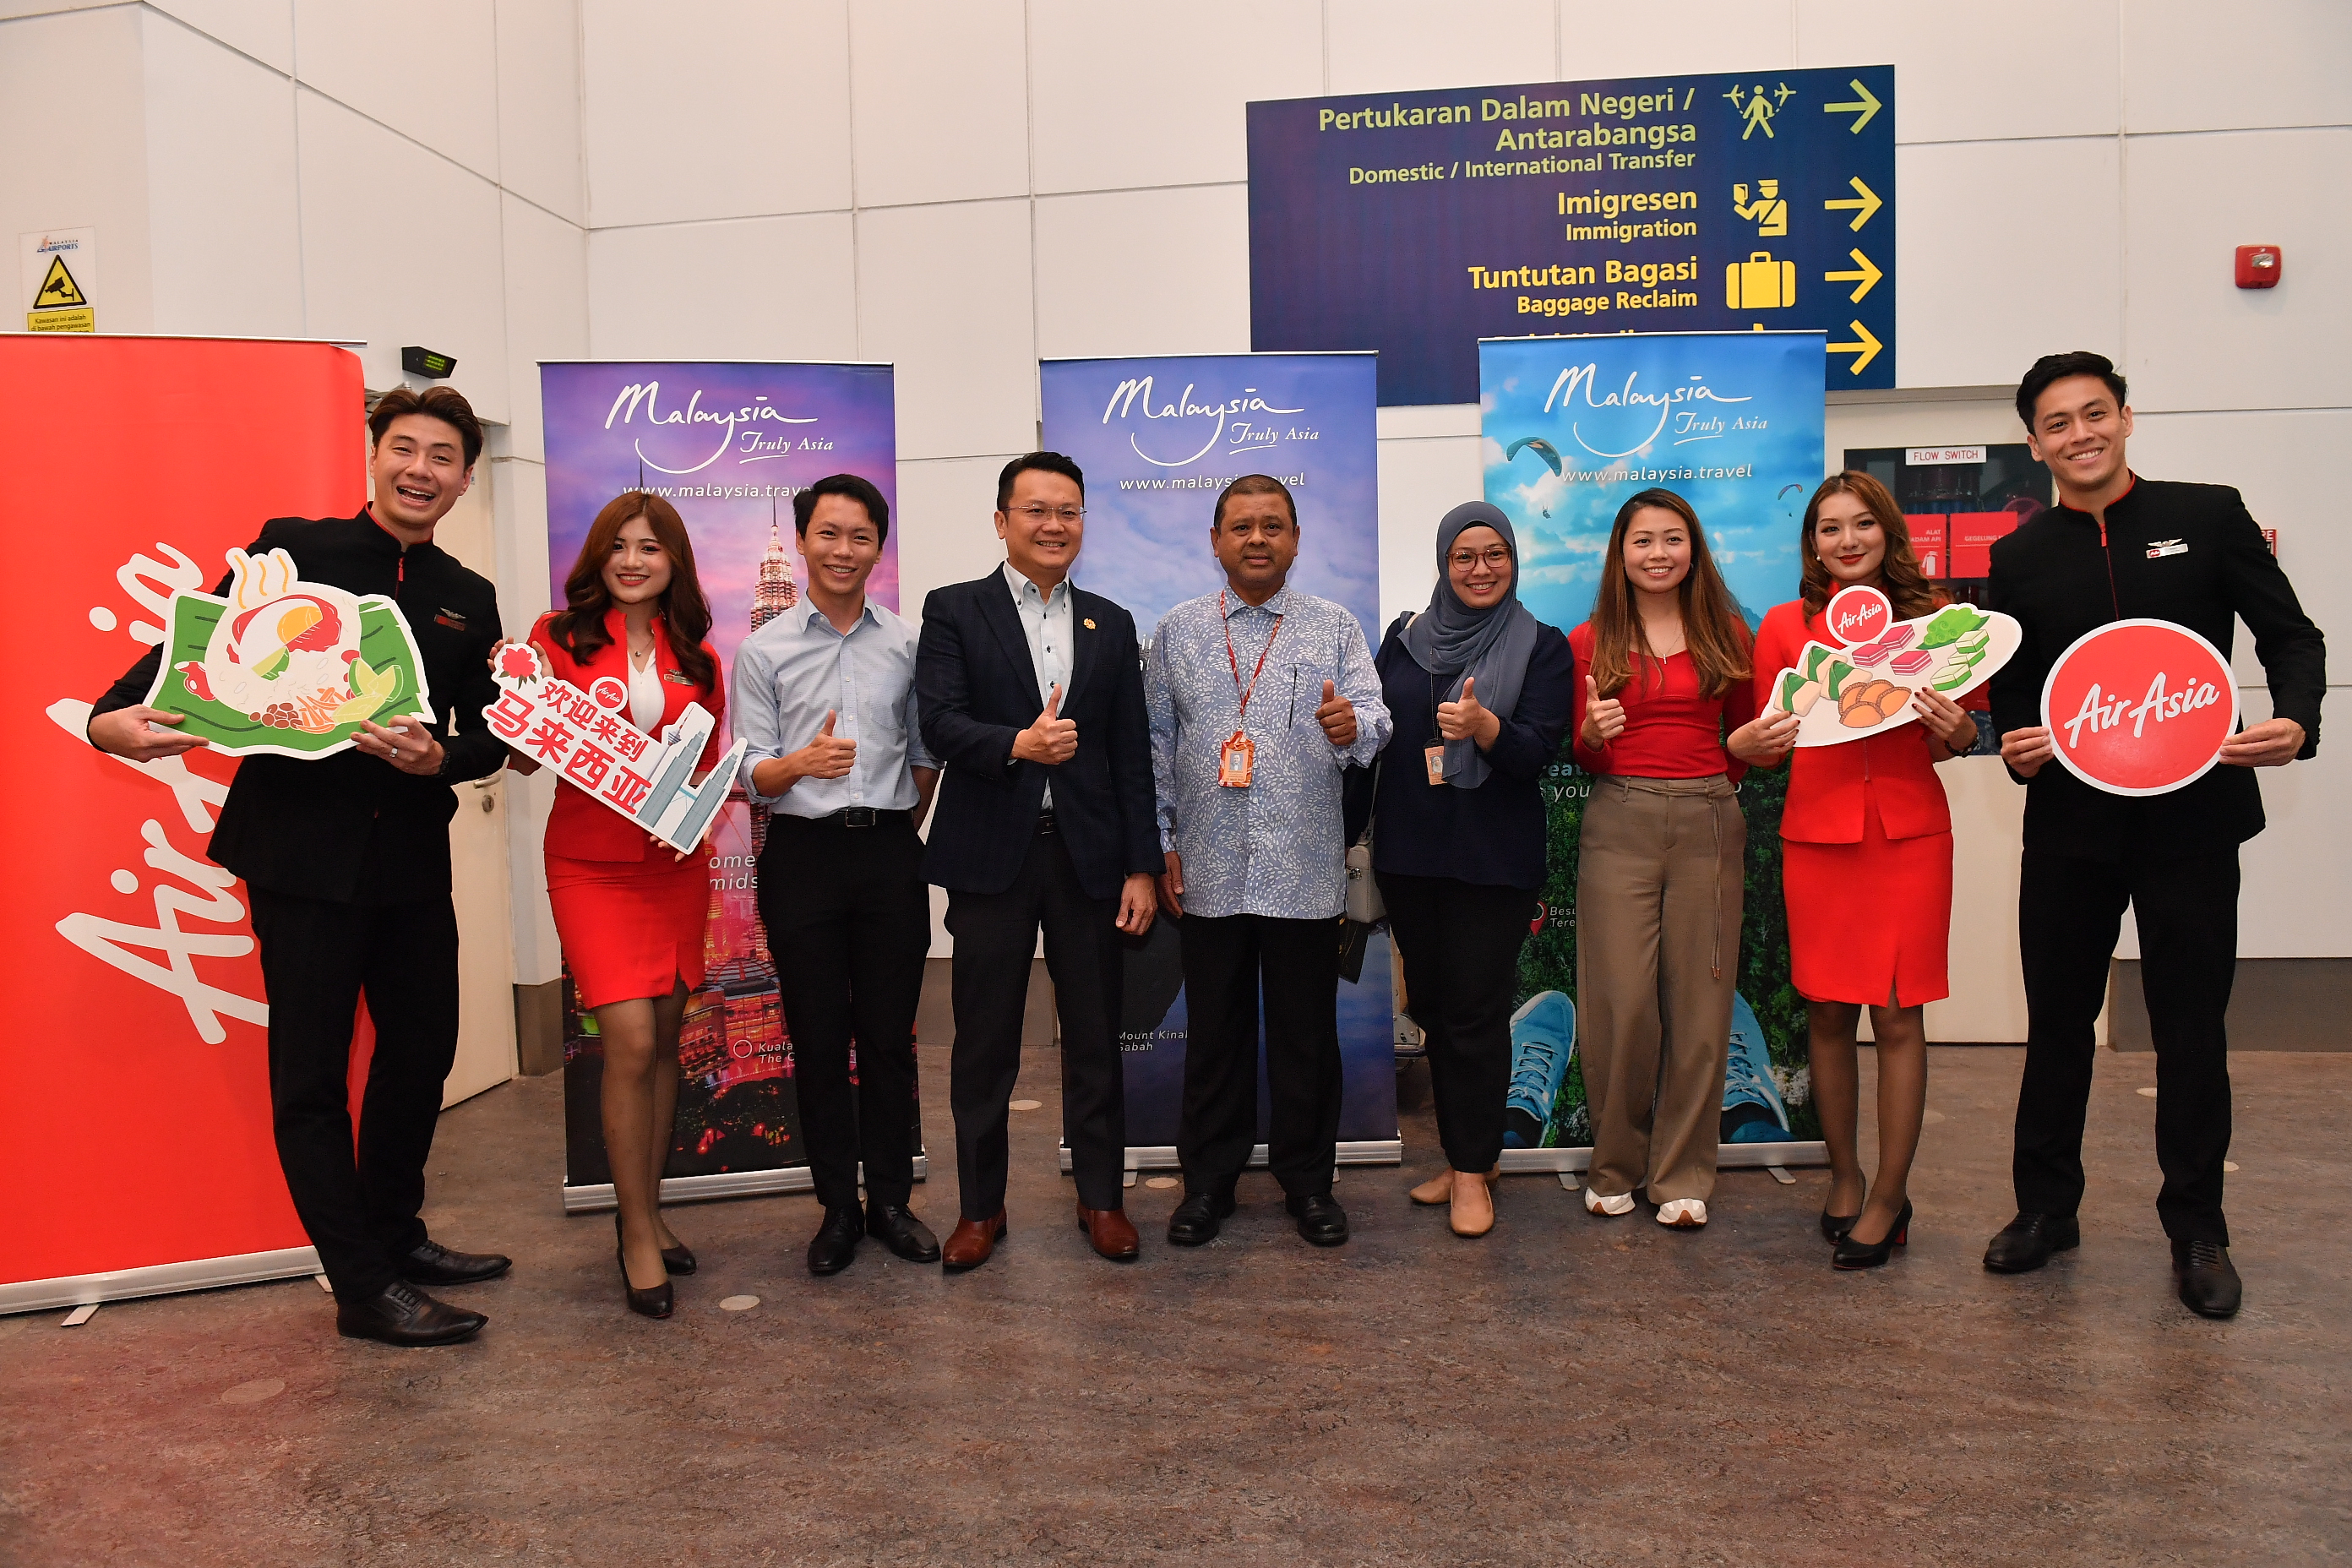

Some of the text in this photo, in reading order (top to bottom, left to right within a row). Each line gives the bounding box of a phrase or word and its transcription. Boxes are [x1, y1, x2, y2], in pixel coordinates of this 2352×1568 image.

[1319, 88, 1696, 131] Pertukaran Dalam Negeri /
[1495, 122, 1696, 152] Antarabangsa
[1348, 150, 1696, 185] Domestic / International Transfer
[1558, 188, 1697, 220] Imigresen
[1566, 218, 1697, 243] Immigration
[47, 242, 79, 252] AIRPORTS
[1467, 255, 1697, 290] Tuntutan Bagasi
[1517, 289, 1697, 318] Baggage Reclaim
[56, 322, 91, 330] pengawasan
[1102, 375, 1304, 466] Malaysia
[1544, 362, 1753, 458] Malaysia
[1674, 411, 1768, 434] Truly Asia
[604, 380, 819, 474] Malaysia
[1229, 422, 1320, 444] Truly Asia
[739, 431, 835, 455] Truly Asia
[1914, 450, 1979, 461] FLOW SWITCH
[1561, 463, 1753, 483] www.malaysia.travel
[1837, 602, 1883, 634] AirAsia
[537, 680, 649, 763] 欢迎来到
[2063, 672, 2220, 749] AirAsia
[486, 689, 653, 815] 马来西亚
[758, 1041, 793, 1053] Kuala
[1119, 1031, 1155, 1040] Mount
[758, 1054, 782, 1064] The
